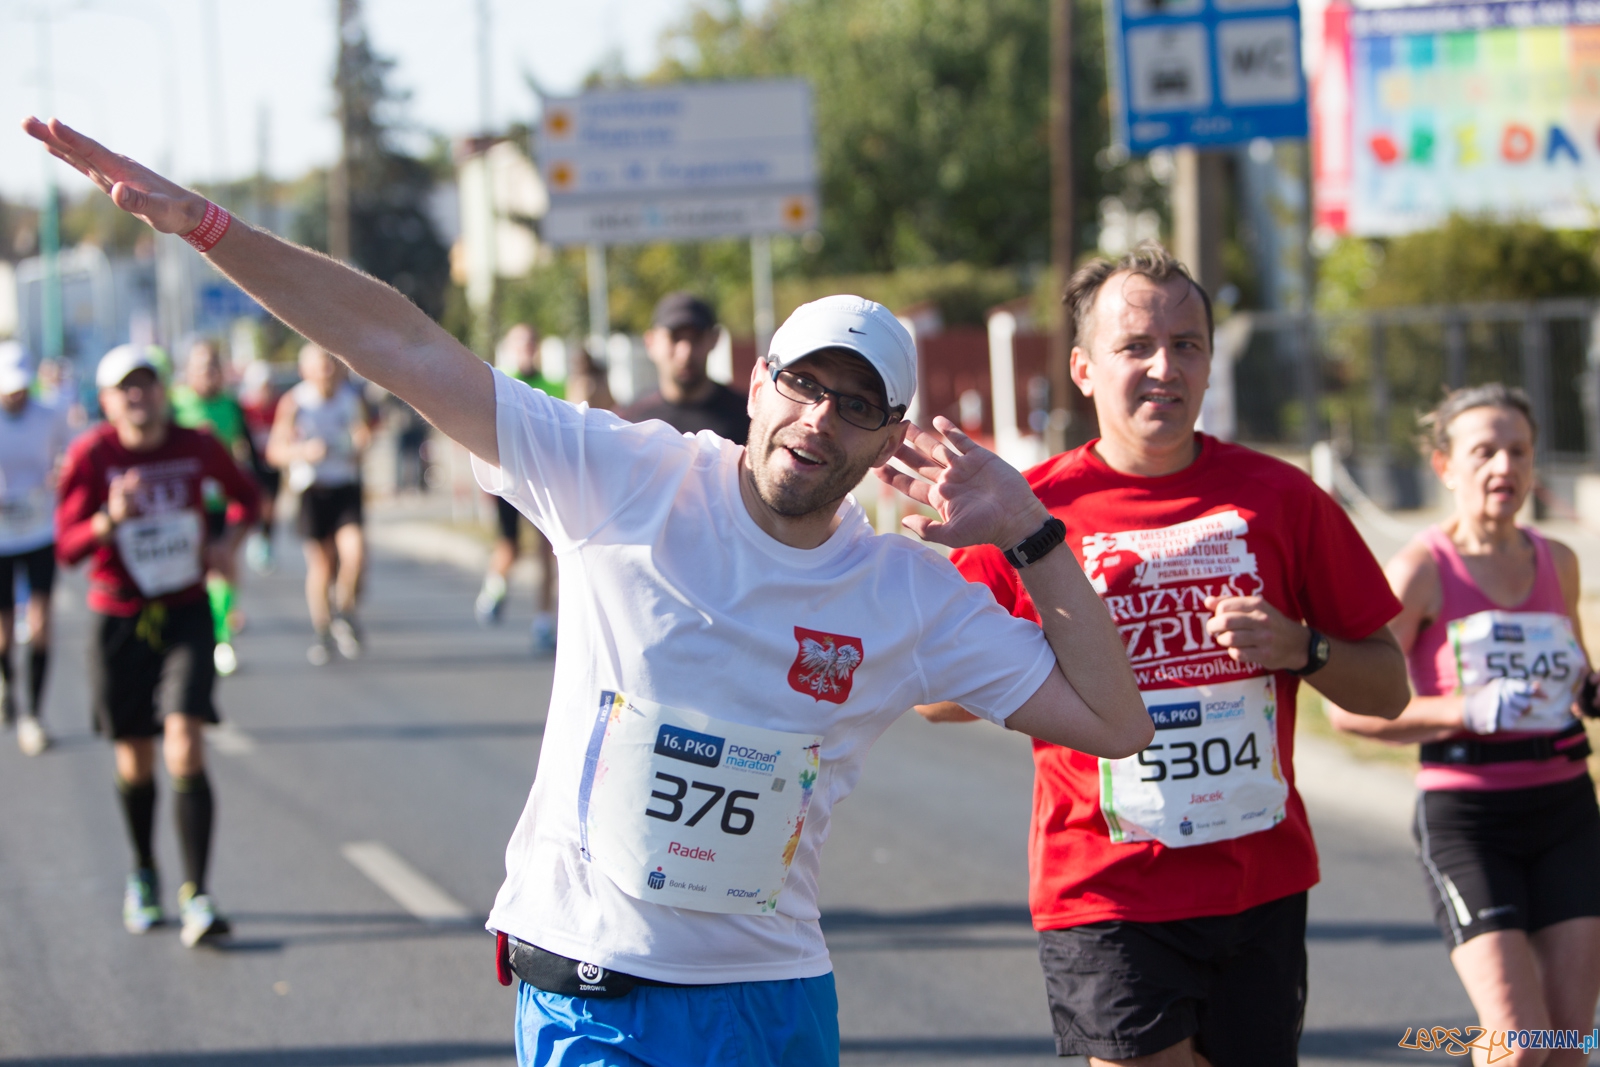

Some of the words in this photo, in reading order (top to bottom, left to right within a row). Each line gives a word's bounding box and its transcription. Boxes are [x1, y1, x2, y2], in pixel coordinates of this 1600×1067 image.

[1231, 37, 1288, 78] WC
[1165, 543, 1229, 558] MARATONIE
[1105, 583, 1234, 620] RUŻYNA
[1486, 652, 1571, 681] 5545
[1171, 708, 1198, 723] PKO
[662, 733, 681, 751] 16.
[684, 740, 718, 758] PKO
[726, 756, 775, 772] maraton
[1138, 732, 1261, 782] 5304
[645, 771, 760, 836] 376
[1189, 791, 1224, 804] Jacek
[668, 842, 717, 863] Radek
[669, 880, 687, 890] Bank
[688, 882, 707, 893] Polski
[582, 963, 598, 977] PZU
